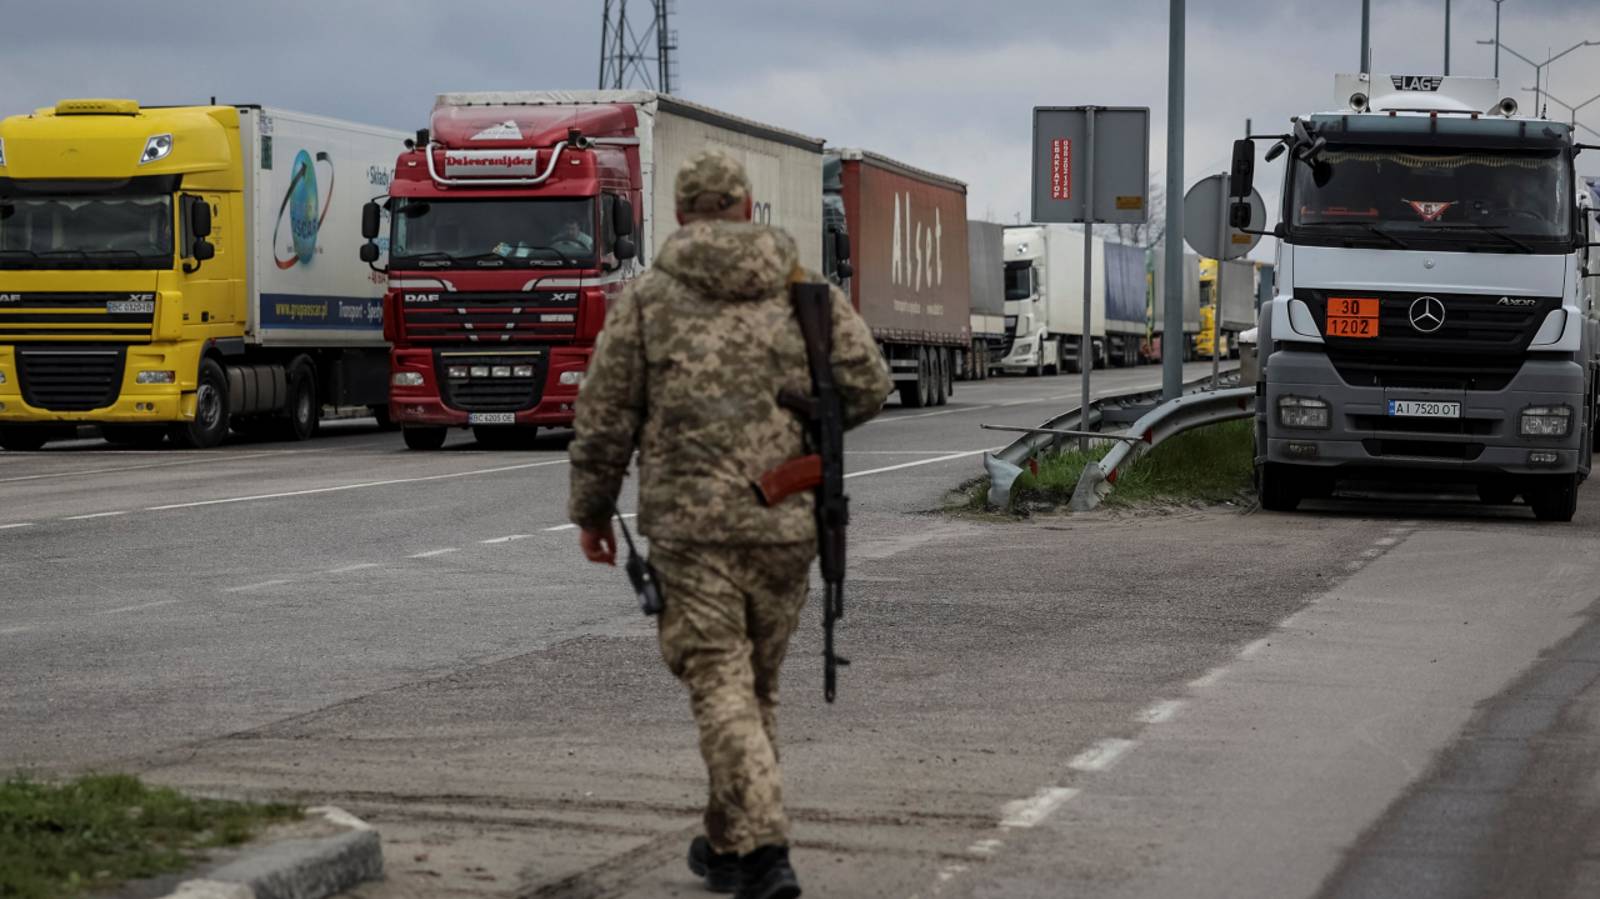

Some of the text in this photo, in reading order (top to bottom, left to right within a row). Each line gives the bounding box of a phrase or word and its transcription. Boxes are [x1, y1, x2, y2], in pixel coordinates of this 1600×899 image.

[1402, 76, 1431, 91] LAG
[892, 191, 942, 293] Alset
[0, 294, 21, 302] AF
[128, 294, 155, 302] XF
[405, 294, 439, 302] DAF
[551, 293, 577, 301] XF
[1342, 300, 1360, 315] 30
[1332, 319, 1369, 334] 1202
[1396, 403, 1460, 416] AI 7520 OT
